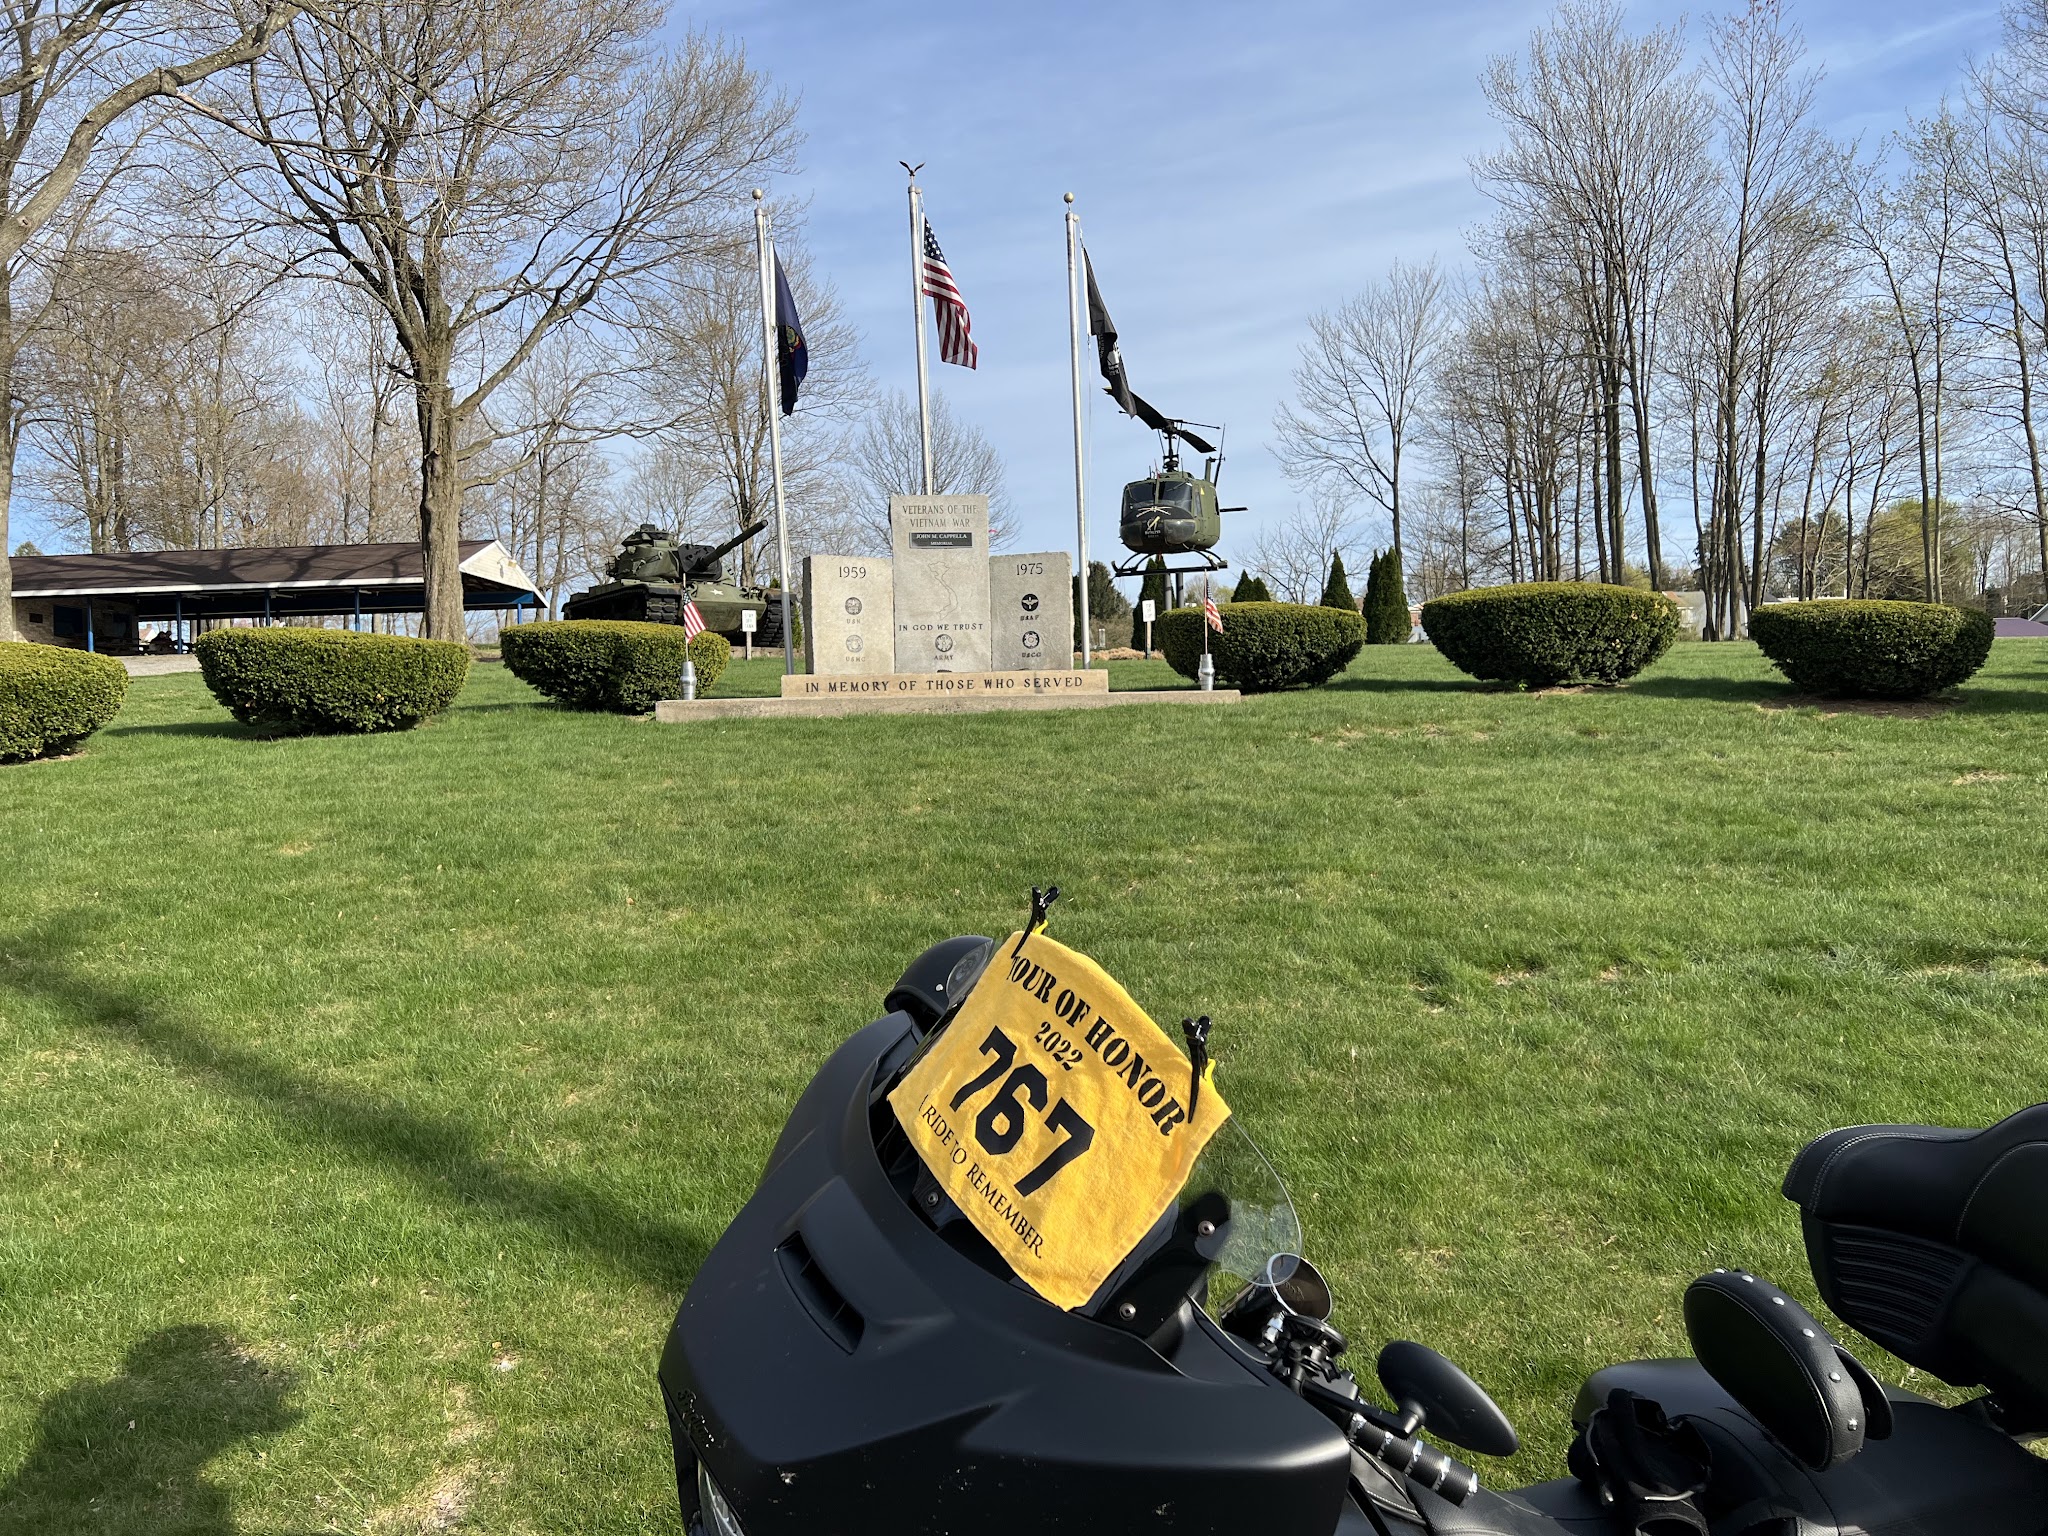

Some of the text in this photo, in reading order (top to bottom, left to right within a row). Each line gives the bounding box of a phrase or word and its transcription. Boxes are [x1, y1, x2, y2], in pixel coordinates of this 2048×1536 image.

[902, 504, 977, 515] VETERANS OF THE
[910, 519, 970, 527] VIETNAM WAR
[839, 566, 867, 579] 1959
[1016, 562, 1043, 576] 1975
[899, 623, 984, 632] IN GOD WE TRUST
[805, 676, 1083, 693] IN MEMORY OF THOSE WHO SERVED
[1033, 1021, 1084, 1071] 2022
[1055, 989, 1091, 1028] OF
[1084, 1015, 1185, 1137] HONOR
[949, 1025, 1095, 1198] 767
[922, 1104, 1043, 1259] RIDE TO REMEMBER
